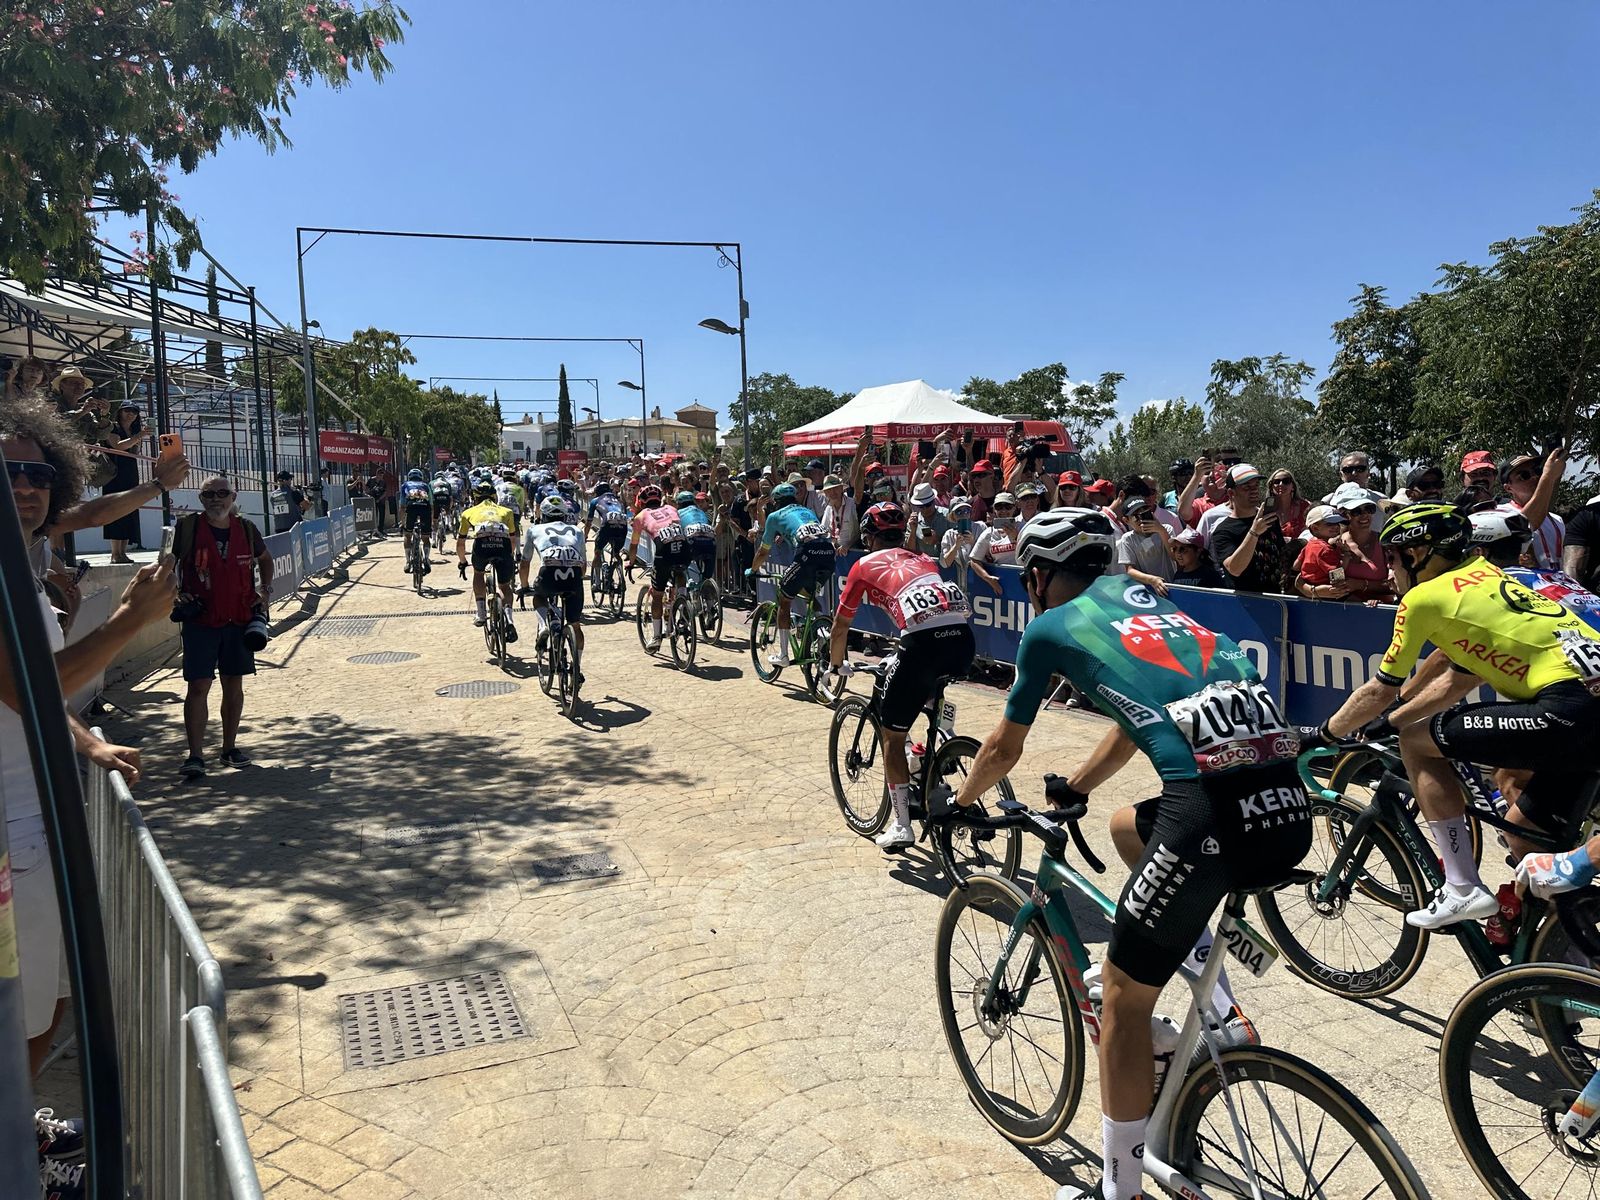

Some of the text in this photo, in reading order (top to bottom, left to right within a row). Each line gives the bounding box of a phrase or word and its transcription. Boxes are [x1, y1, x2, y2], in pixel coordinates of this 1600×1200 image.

[895, 425, 926, 435] TIENDA
[323, 445, 365, 456] ORGANIZACIÓN
[367, 446, 389, 457] TOCOLO
[670, 541, 683, 552] EF
[870, 588, 899, 618] Cofidis
[905, 588, 940, 613] 183
[934, 630, 962, 639] Cofidis
[1384, 602, 1409, 665] ARKEA
[1452, 637, 1532, 682] ARKEA
[941, 702, 955, 722] 183
[1098, 686, 1154, 724] FINISHER
[1463, 715, 1549, 731] B&B HOTELS
[1238, 786, 1306, 819] KERN
[1123, 842, 1180, 920] KERN
[1144, 862, 1195, 929] PHARMA
[1226, 929, 1267, 976] 204
